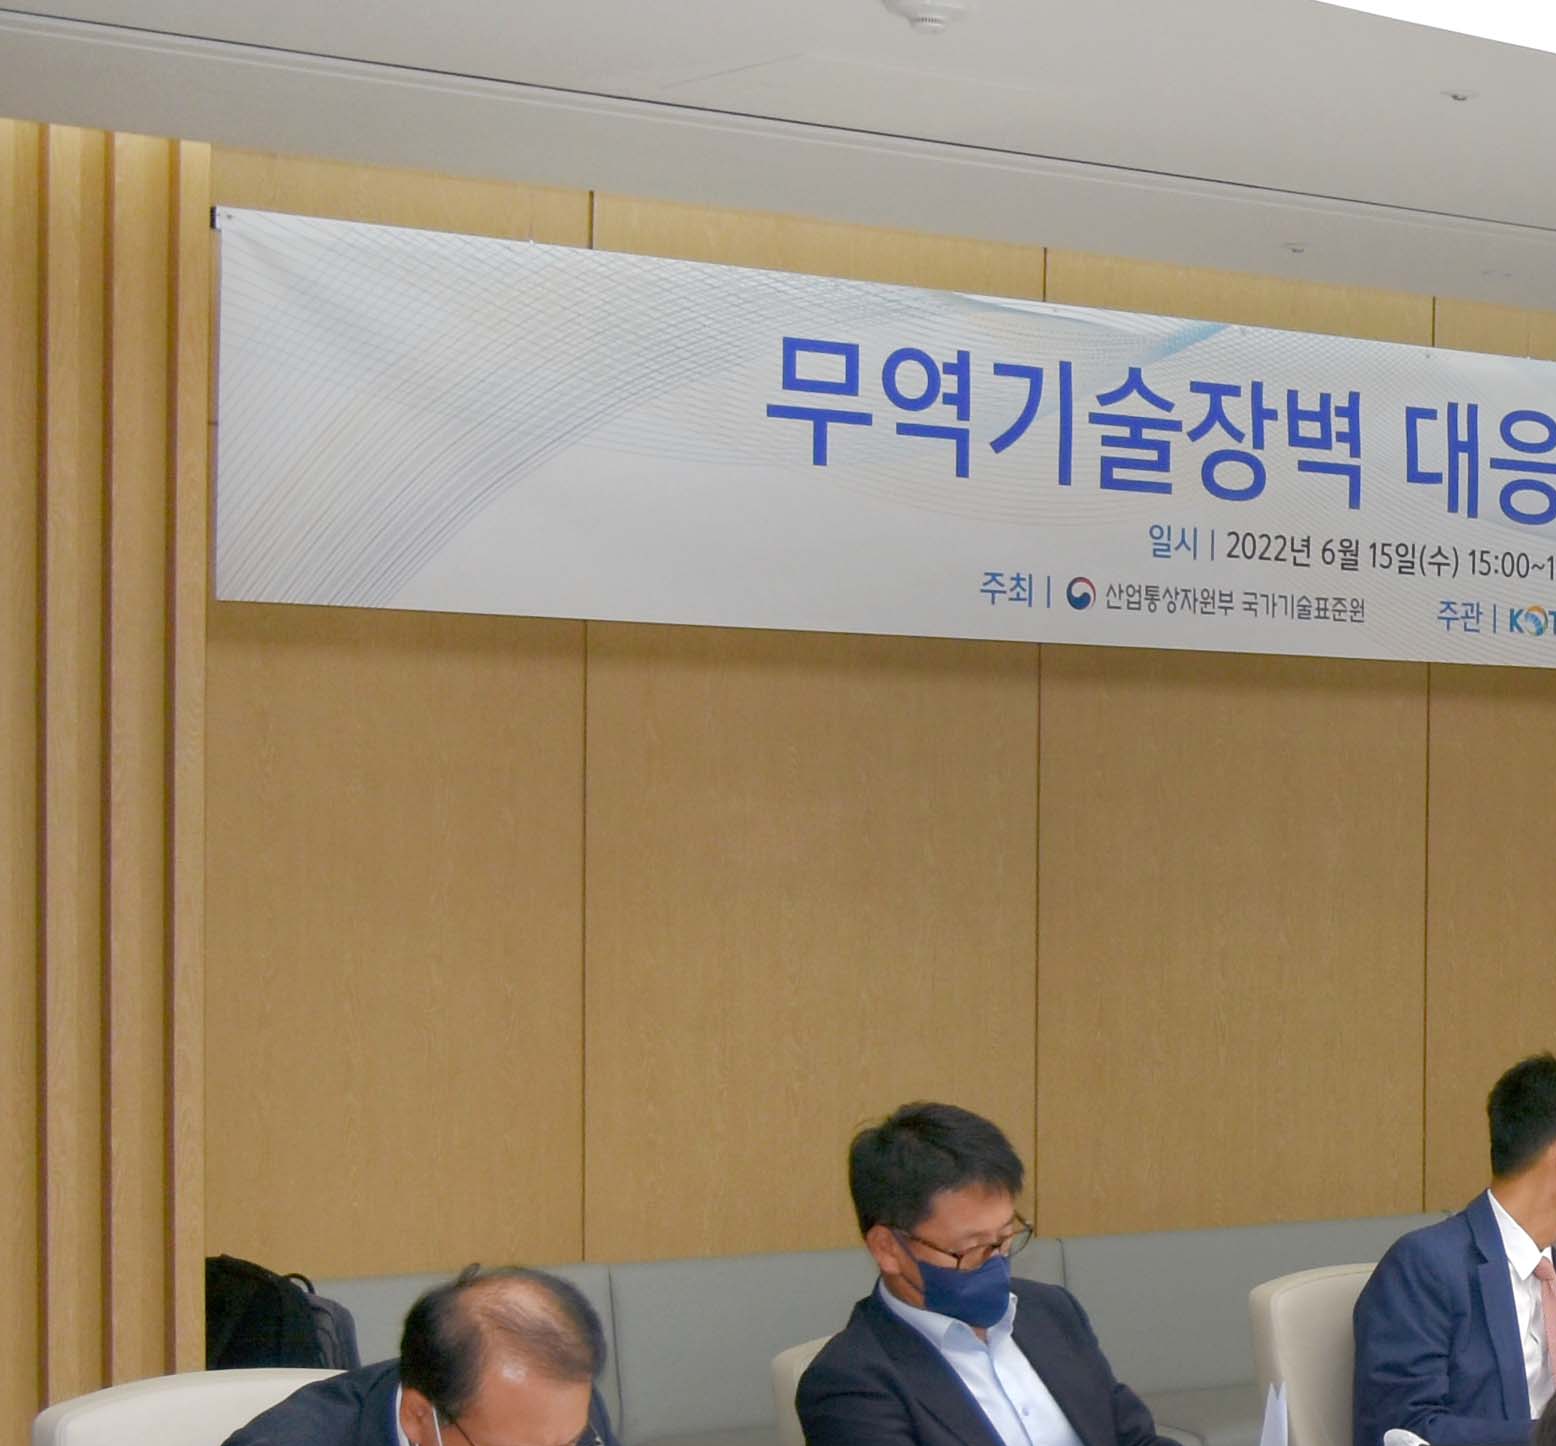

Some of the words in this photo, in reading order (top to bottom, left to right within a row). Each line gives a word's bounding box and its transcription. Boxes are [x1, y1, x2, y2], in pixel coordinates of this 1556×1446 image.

[766, 336, 1361, 510] 무역기술장벽
[1148, 523, 1198, 560] 일시
[1226, 530, 1311, 568] 2022년
[1321, 538, 1360, 571] 6월
[1369, 541, 1460, 578] 15일(수)
[979, 571, 1034, 608] 주최
[1105, 582, 1235, 617] 산업통상자원부
[1241, 590, 1366, 624] 국가기술표준원
[1436, 600, 1484, 634] 주관
